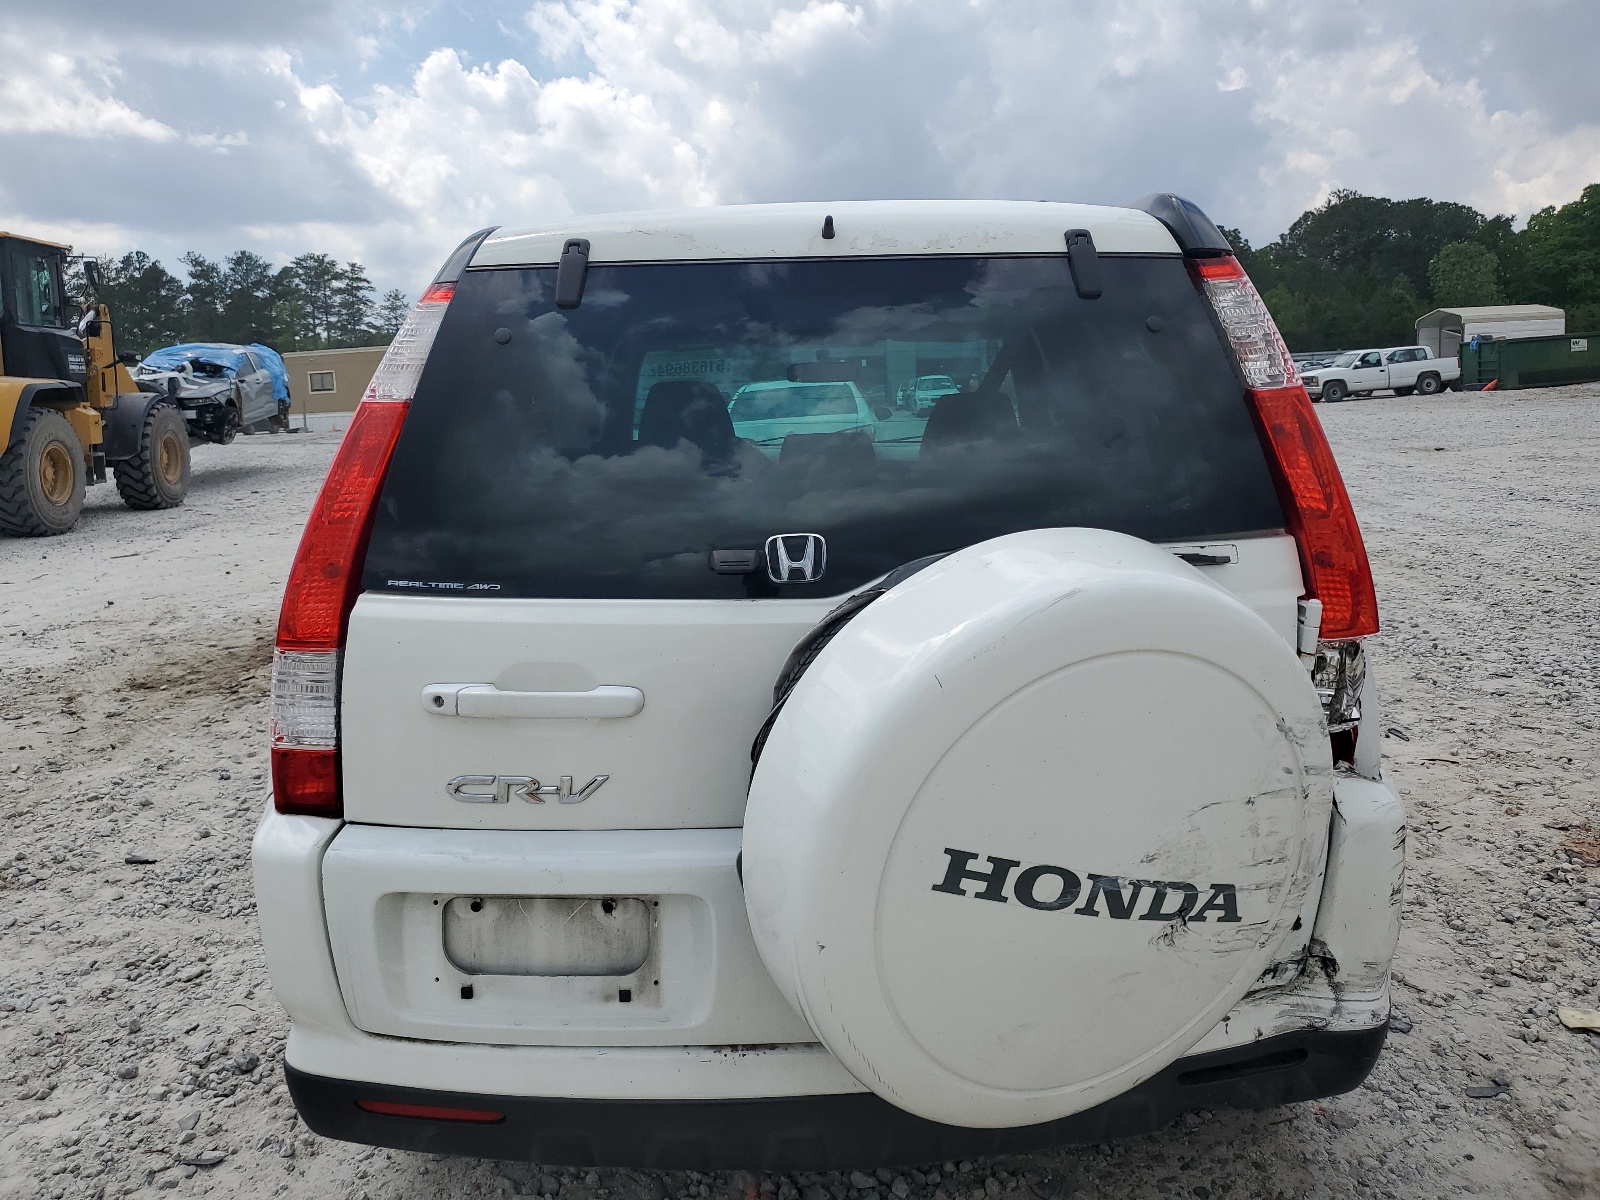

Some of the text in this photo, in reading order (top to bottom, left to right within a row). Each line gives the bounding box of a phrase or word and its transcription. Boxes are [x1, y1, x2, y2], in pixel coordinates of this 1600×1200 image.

[387, 579, 464, 590] REALTIME
[446, 774, 610, 804] CR-V
[931, 847, 1243, 923] HONDA
